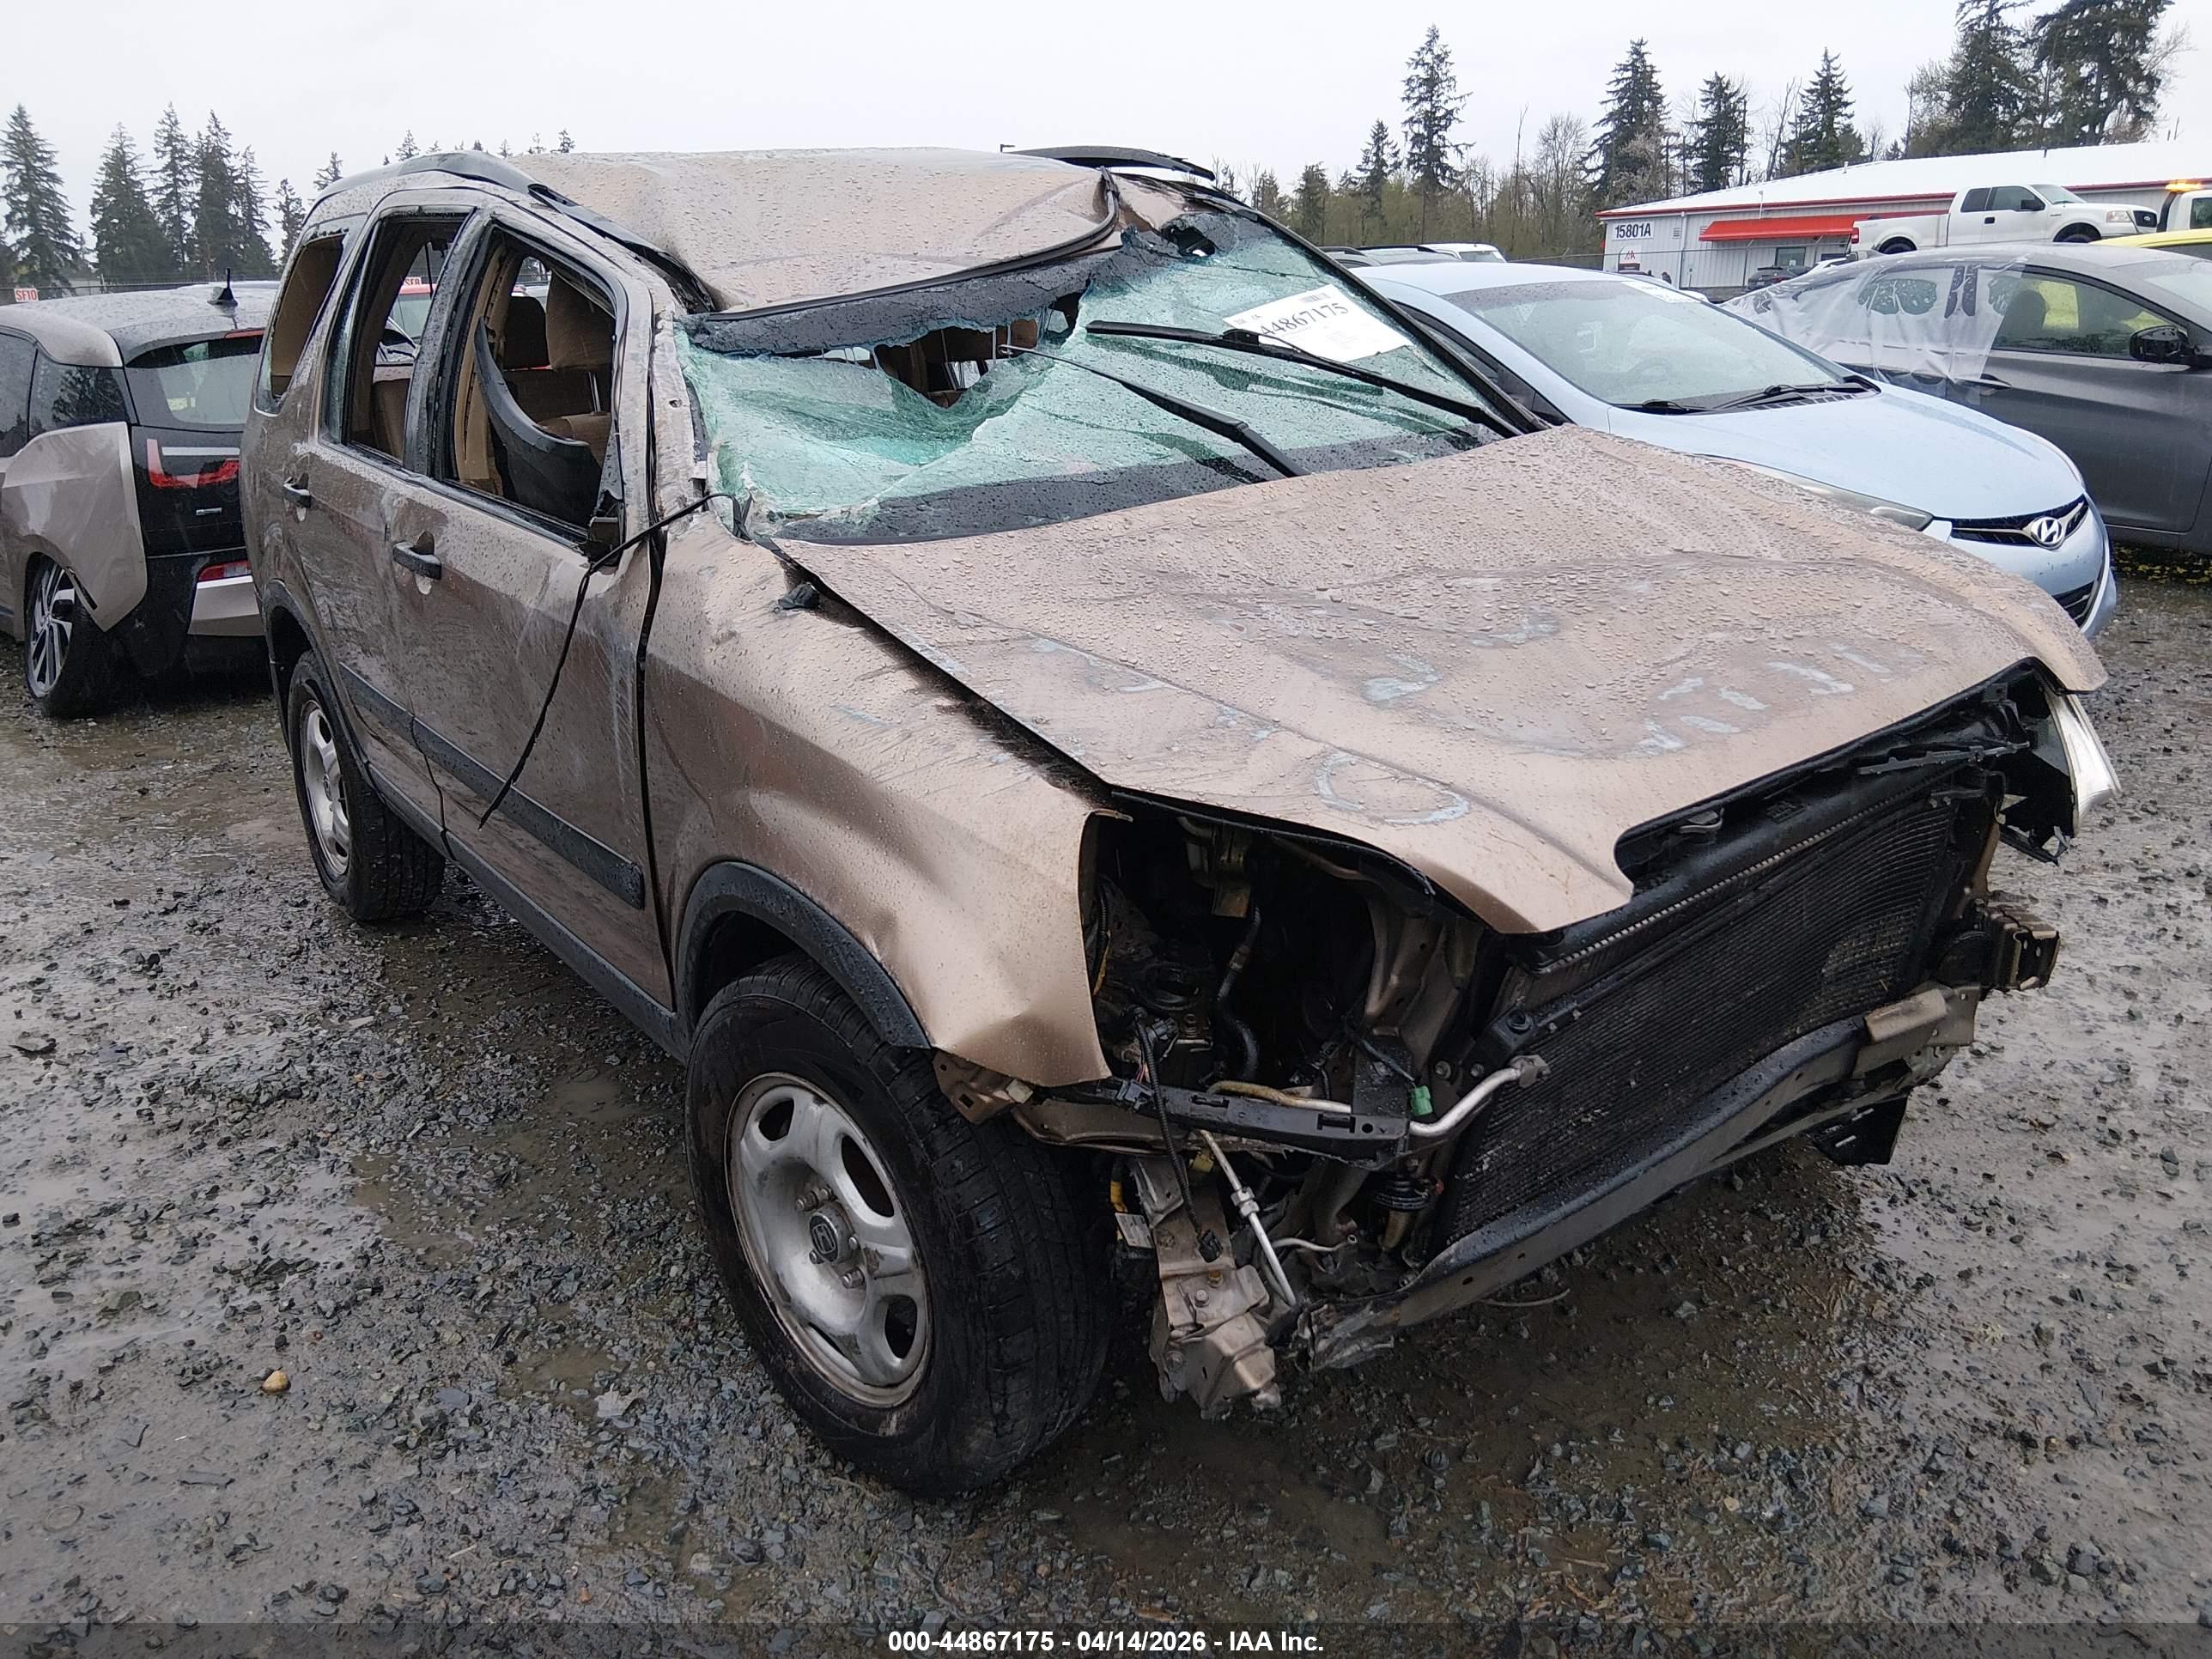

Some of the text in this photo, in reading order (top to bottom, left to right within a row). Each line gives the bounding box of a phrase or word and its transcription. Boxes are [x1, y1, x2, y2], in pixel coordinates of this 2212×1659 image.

[1614, 222, 1651, 239] 15801A
[16, 289, 37, 301] SF10
[1260, 302, 1349, 336] 44867175
